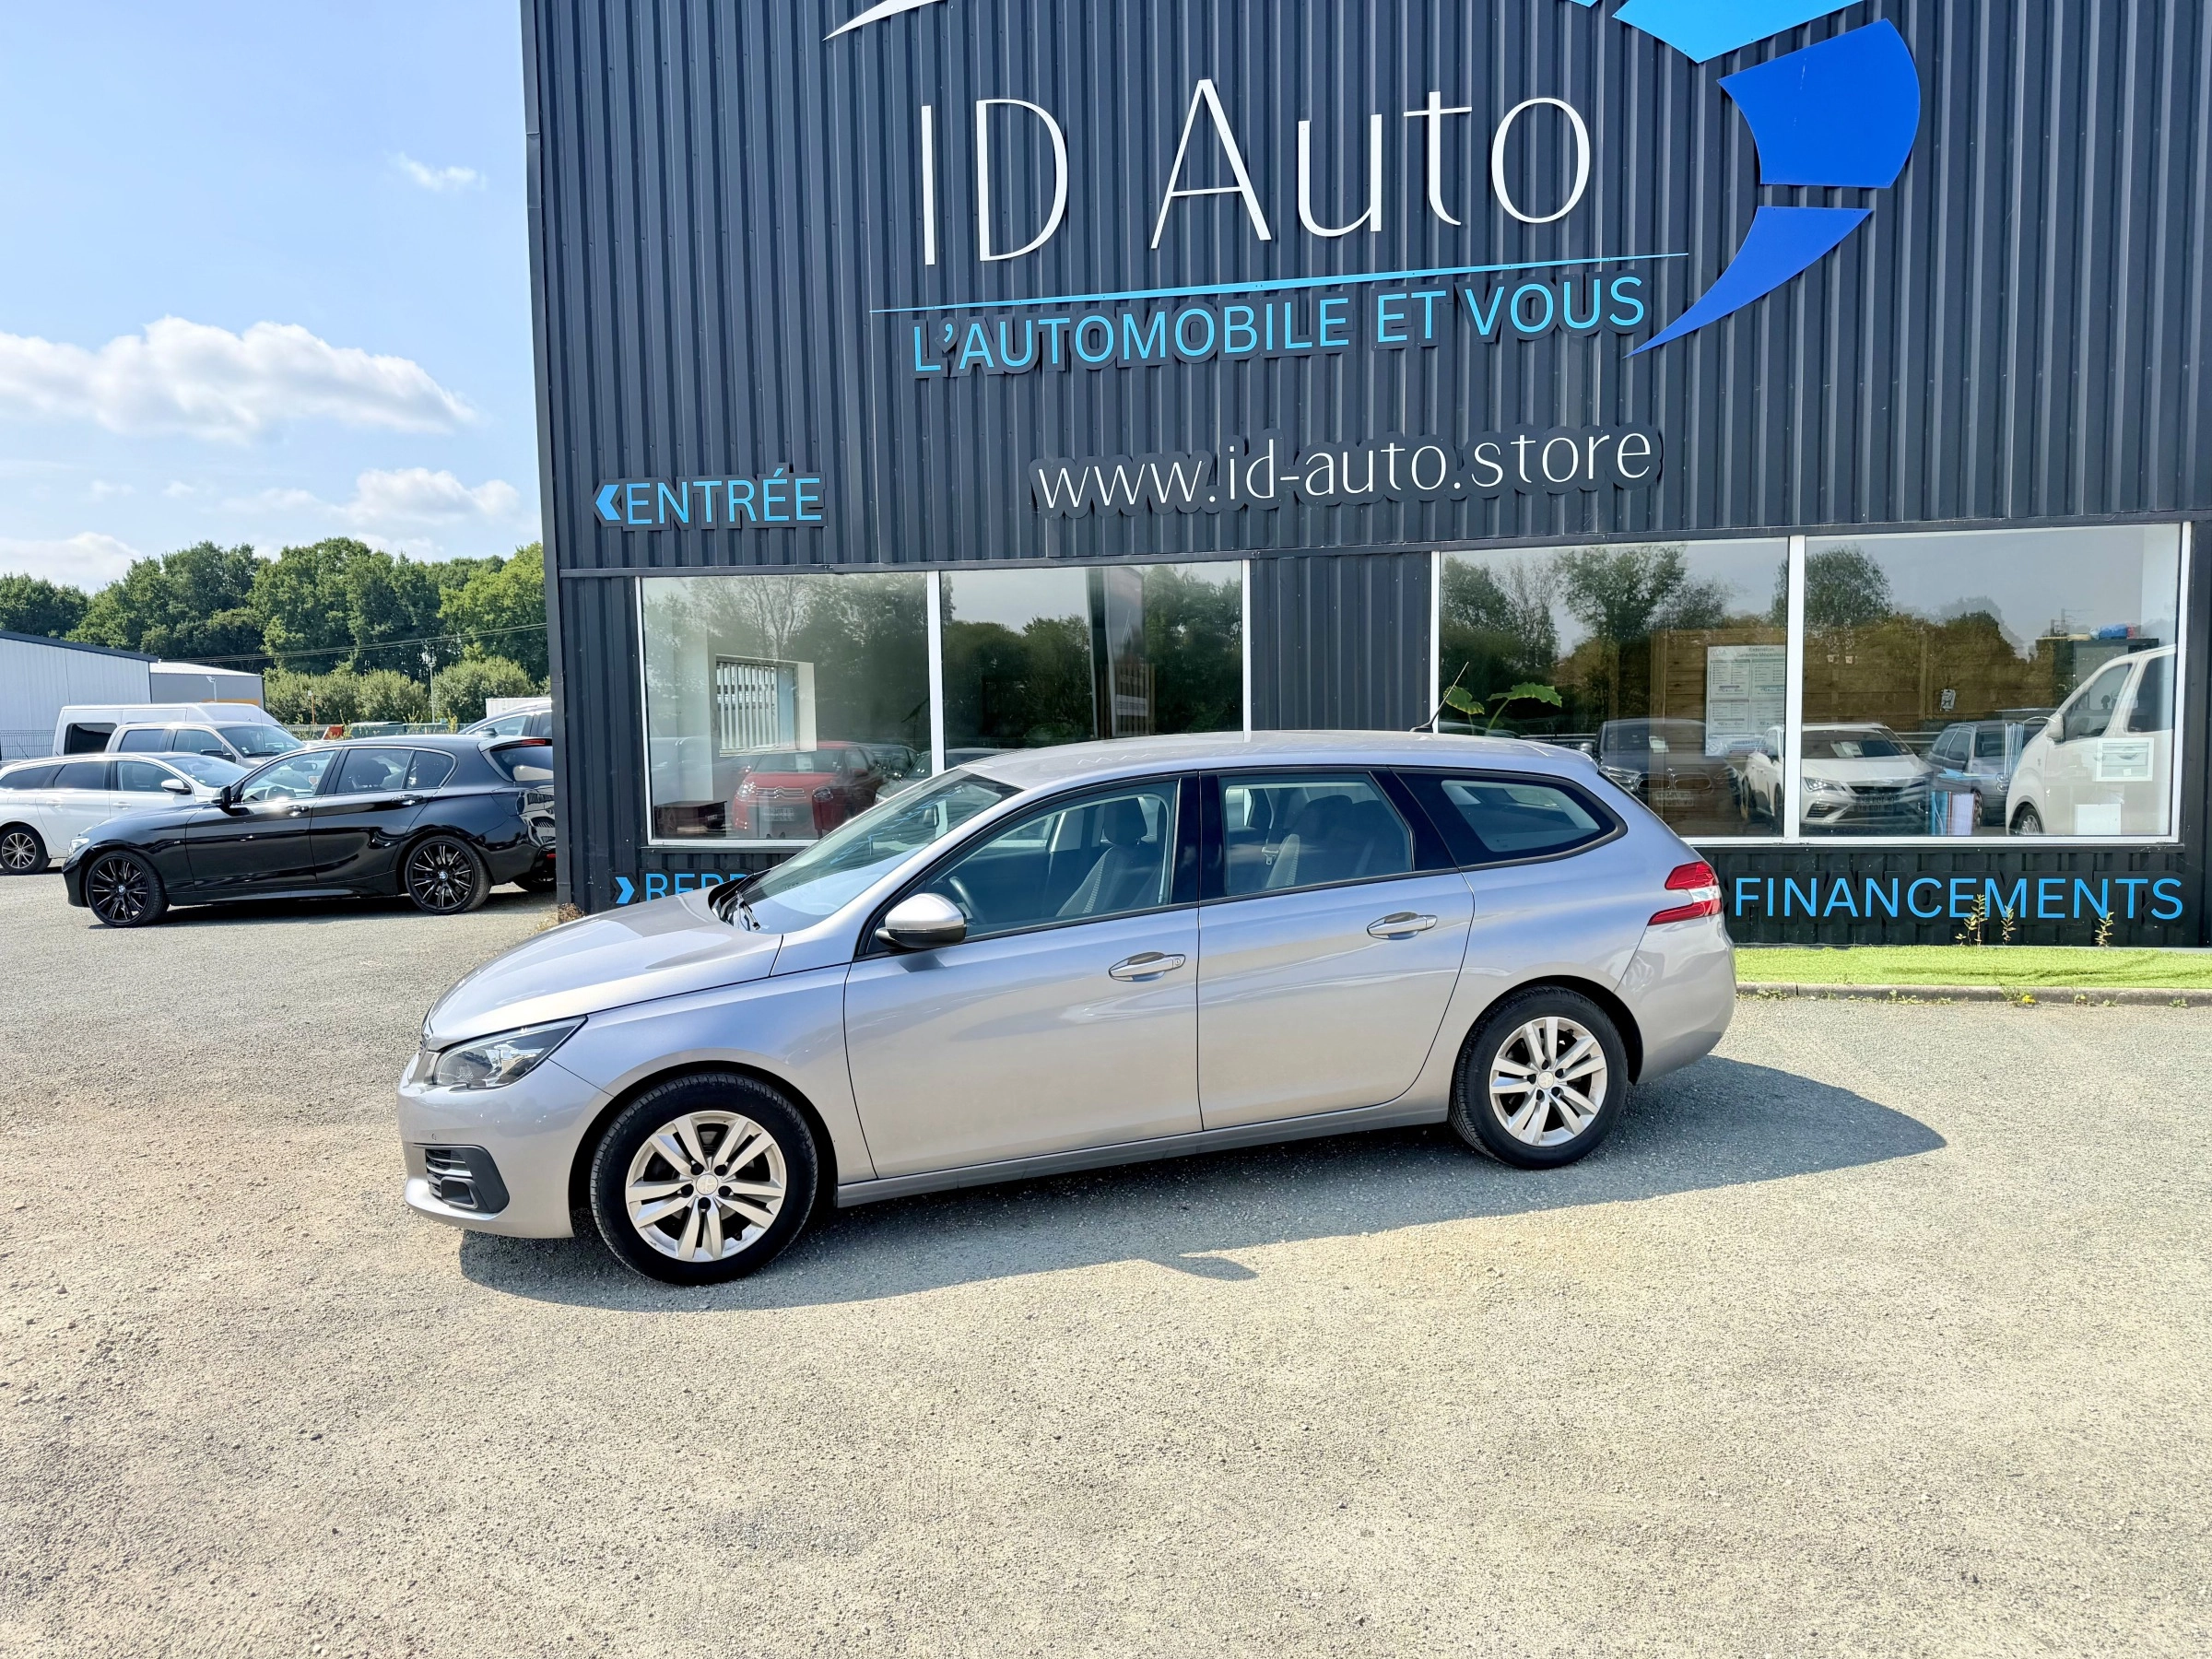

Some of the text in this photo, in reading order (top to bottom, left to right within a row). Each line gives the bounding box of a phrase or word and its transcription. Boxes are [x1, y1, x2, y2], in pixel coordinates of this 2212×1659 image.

[921, 78, 1591, 265] ID Auto
[1376, 289, 1448, 344] ET
[1465, 276, 1645, 337] VOUS
[627, 468, 823, 525] ENTRÉE
[1038, 432, 1652, 509] www.id-auto.store
[1734, 877, 2184, 921] FINANCEMENTS
